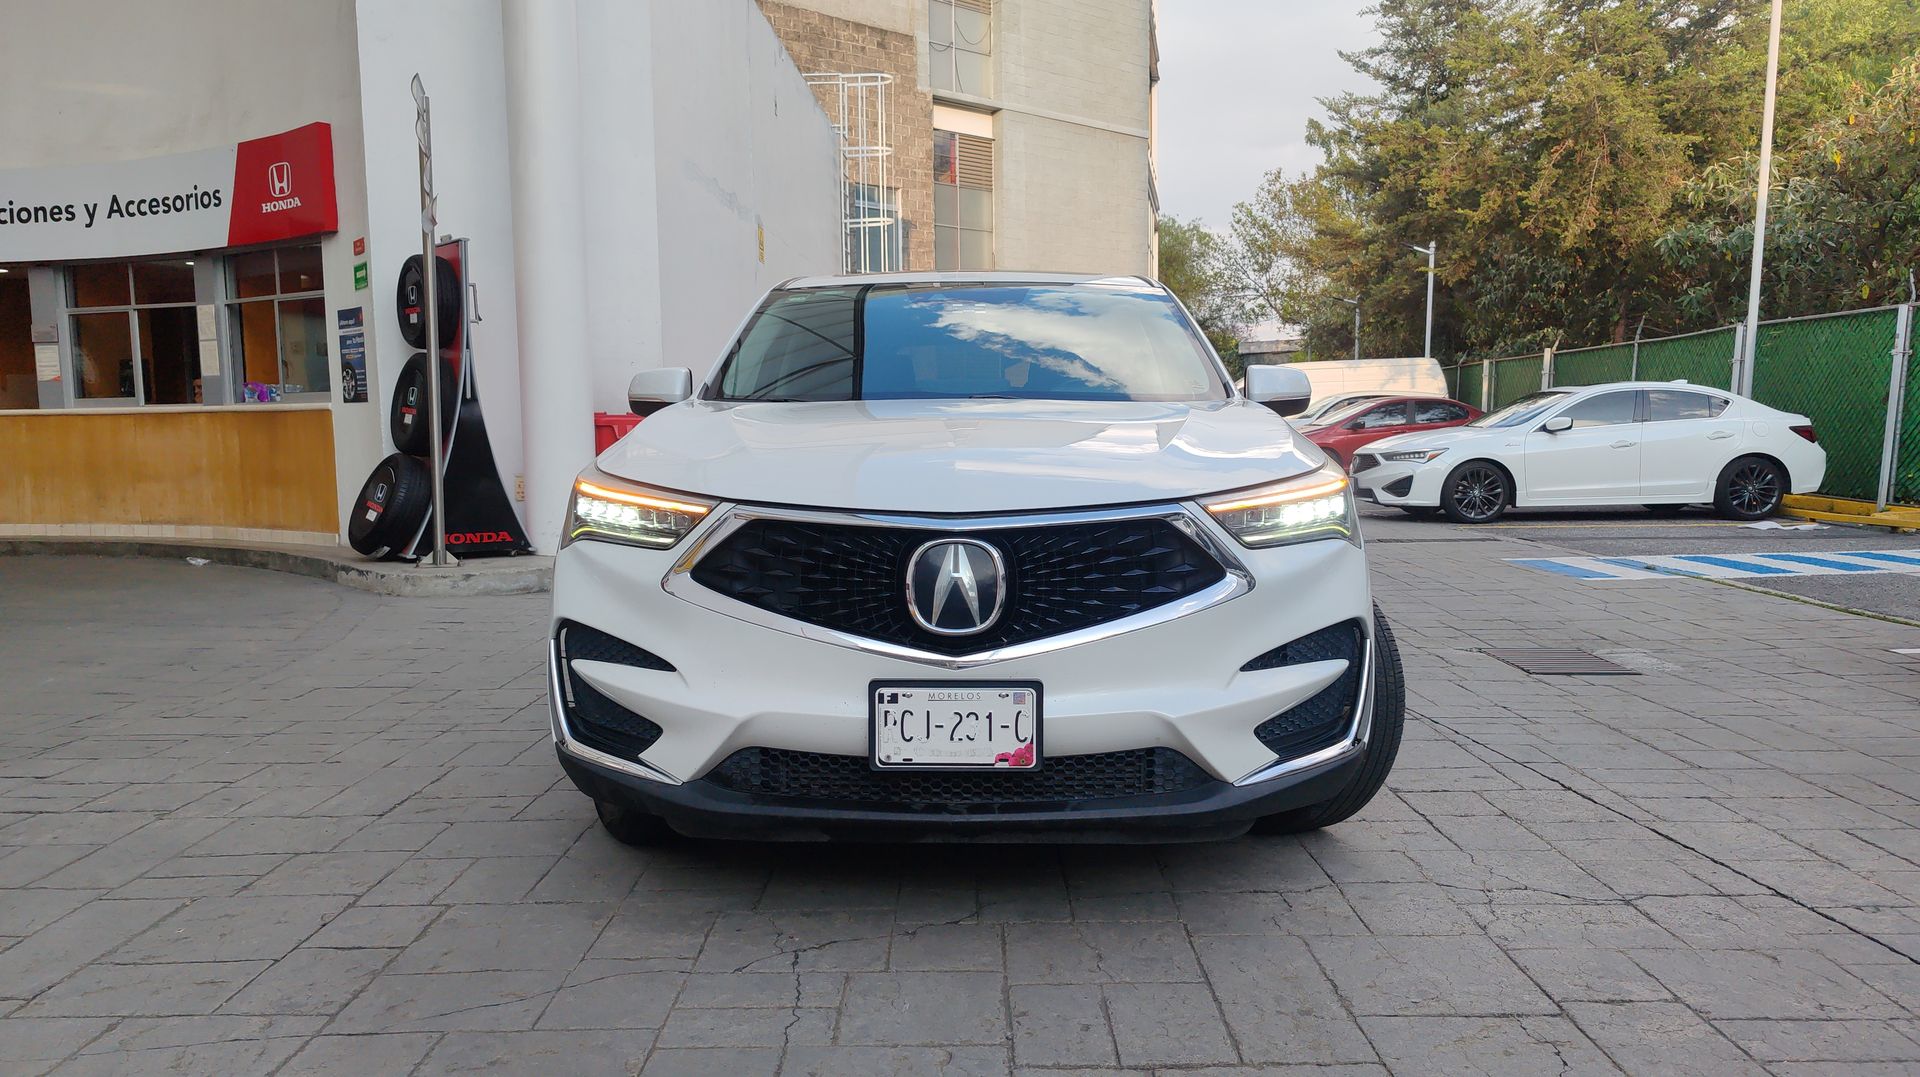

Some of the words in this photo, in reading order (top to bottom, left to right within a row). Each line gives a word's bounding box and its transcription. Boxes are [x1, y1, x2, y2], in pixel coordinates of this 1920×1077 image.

[83, 202, 98, 228] y
[106, 184, 222, 220] Accesorios
[261, 197, 302, 213] HONDA
[444, 531, 514, 545] ONDA
[928, 691, 982, 701] MORELOS
